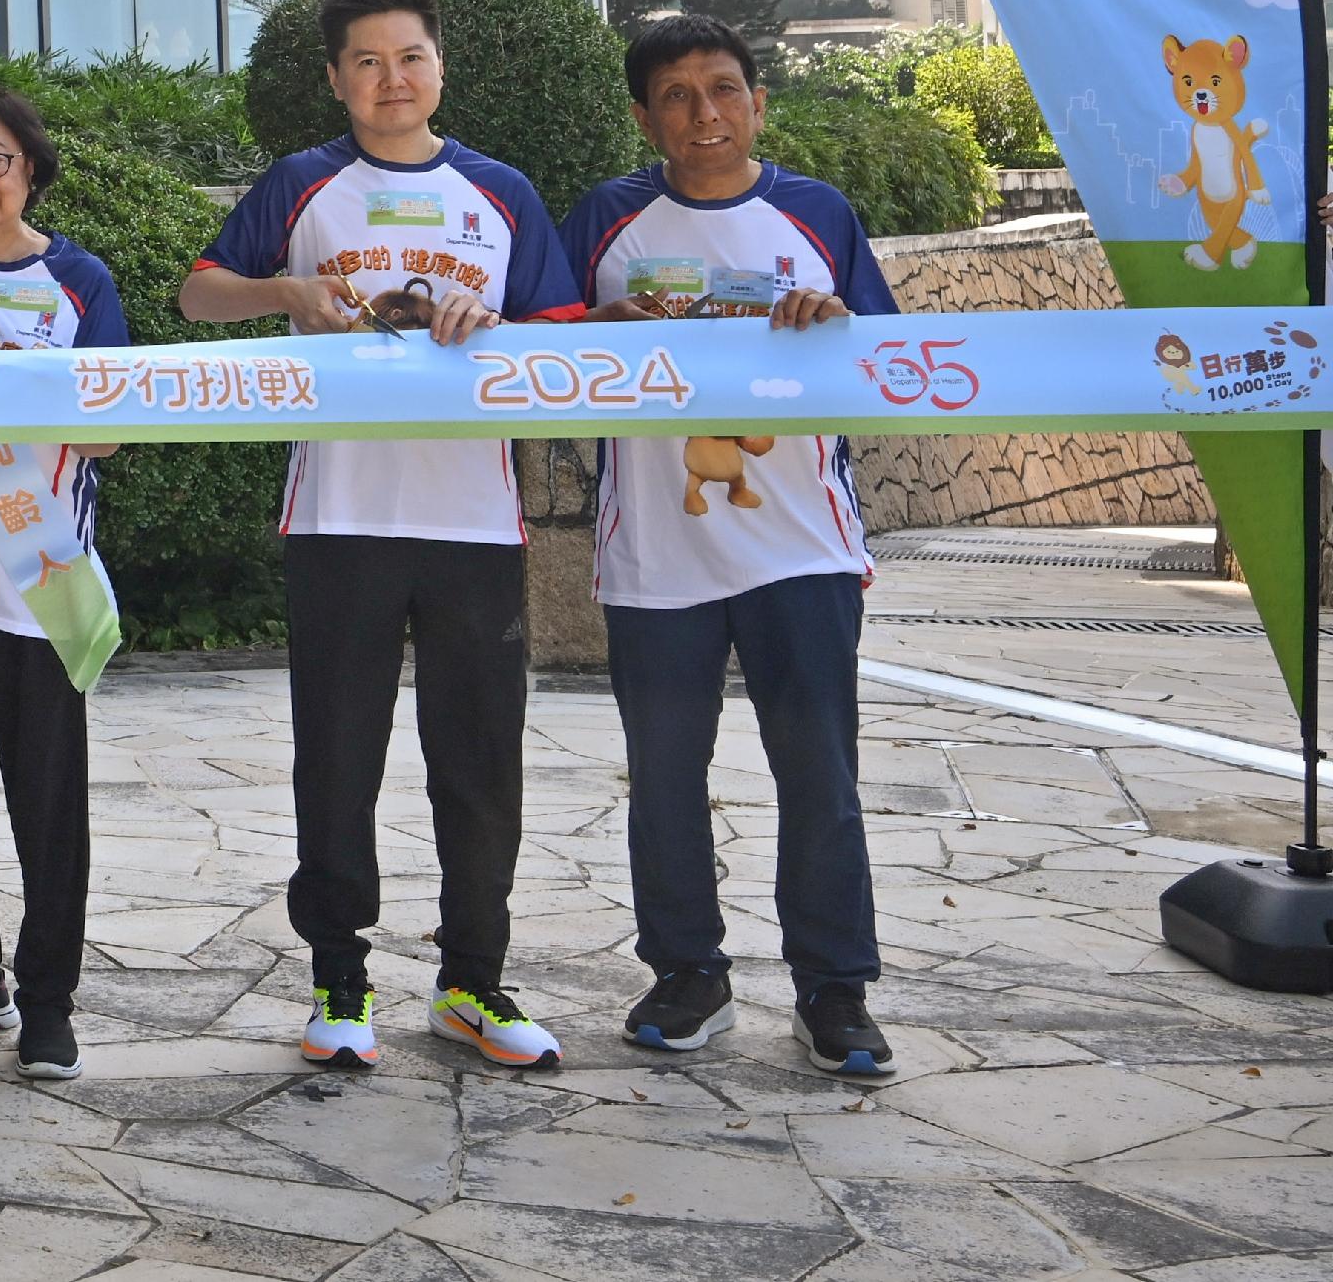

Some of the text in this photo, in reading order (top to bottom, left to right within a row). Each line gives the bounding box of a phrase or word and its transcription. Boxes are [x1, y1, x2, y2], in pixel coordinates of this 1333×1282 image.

[74, 356, 318, 410] 步行挑戰
[474, 350, 694, 408] 2024
[875, 338, 979, 410] 35
[1200, 350, 1286, 379] 日行萬步
[1208, 378, 1264, 401] 10,000
